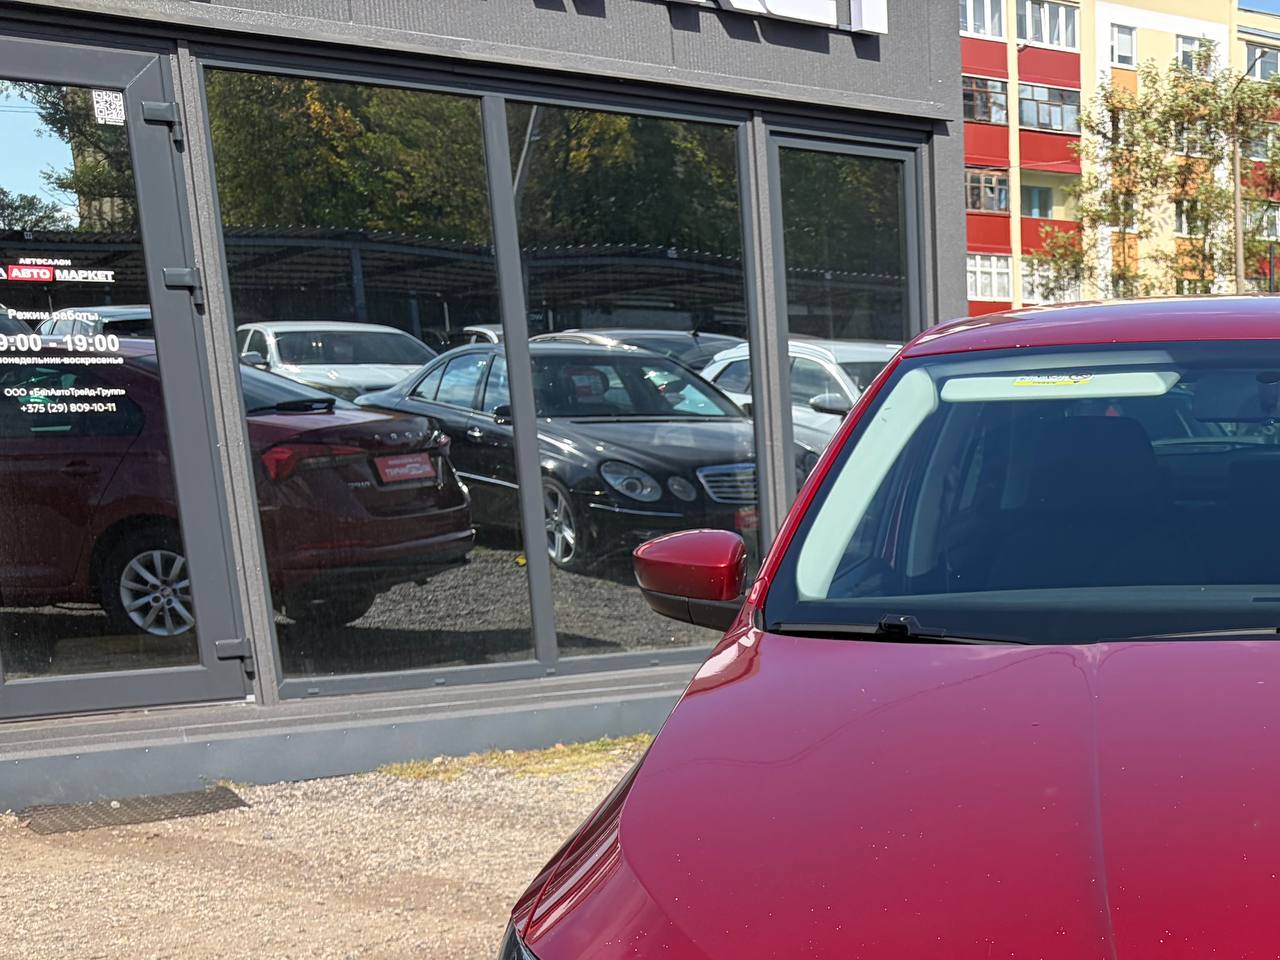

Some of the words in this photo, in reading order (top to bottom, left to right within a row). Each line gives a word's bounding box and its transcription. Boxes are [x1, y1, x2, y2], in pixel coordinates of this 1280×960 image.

[19, 258, 72, 266] АВТОСАЛОН
[11, 268, 51, 279] АВТО
[54, 269, 115, 281] МАРКЕТ
[7, 308, 49, 320] Режим
[62, 334, 120, 352] 19:00
[4, 388, 27, 397] ООО
[20, 403, 46, 413] +375
[47, 402, 68, 413] (29)
[69, 403, 117, 412] 809-10-11
